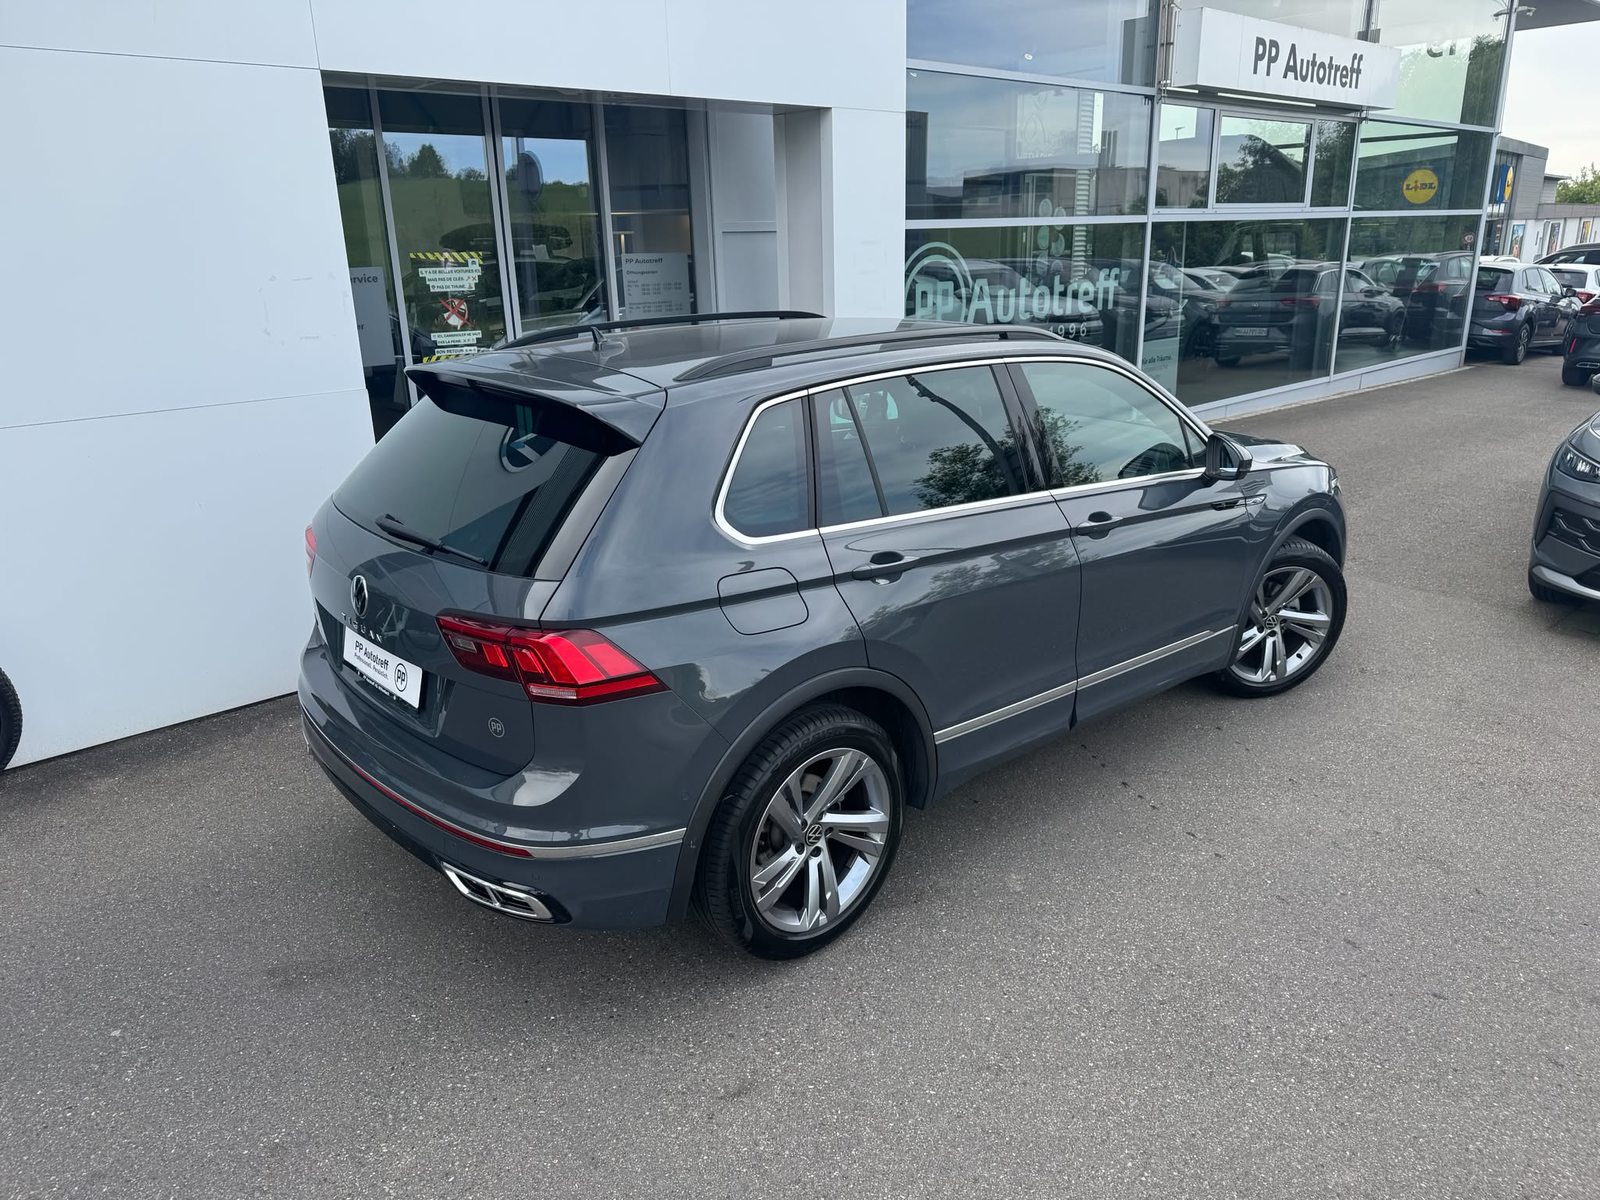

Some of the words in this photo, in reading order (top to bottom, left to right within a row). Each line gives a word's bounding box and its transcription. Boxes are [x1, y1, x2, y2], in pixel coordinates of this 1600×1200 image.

[1252, 35, 1280, 76] PP
[1283, 42, 1364, 90] Autotreff
[915, 280, 954, 322] PP
[967, 267, 1120, 325] Autotreff
[354, 640, 364, 653] PP
[363, 647, 389, 671] Autotreff
[396, 669, 406, 686] PP
[491, 721, 501, 733] PP
